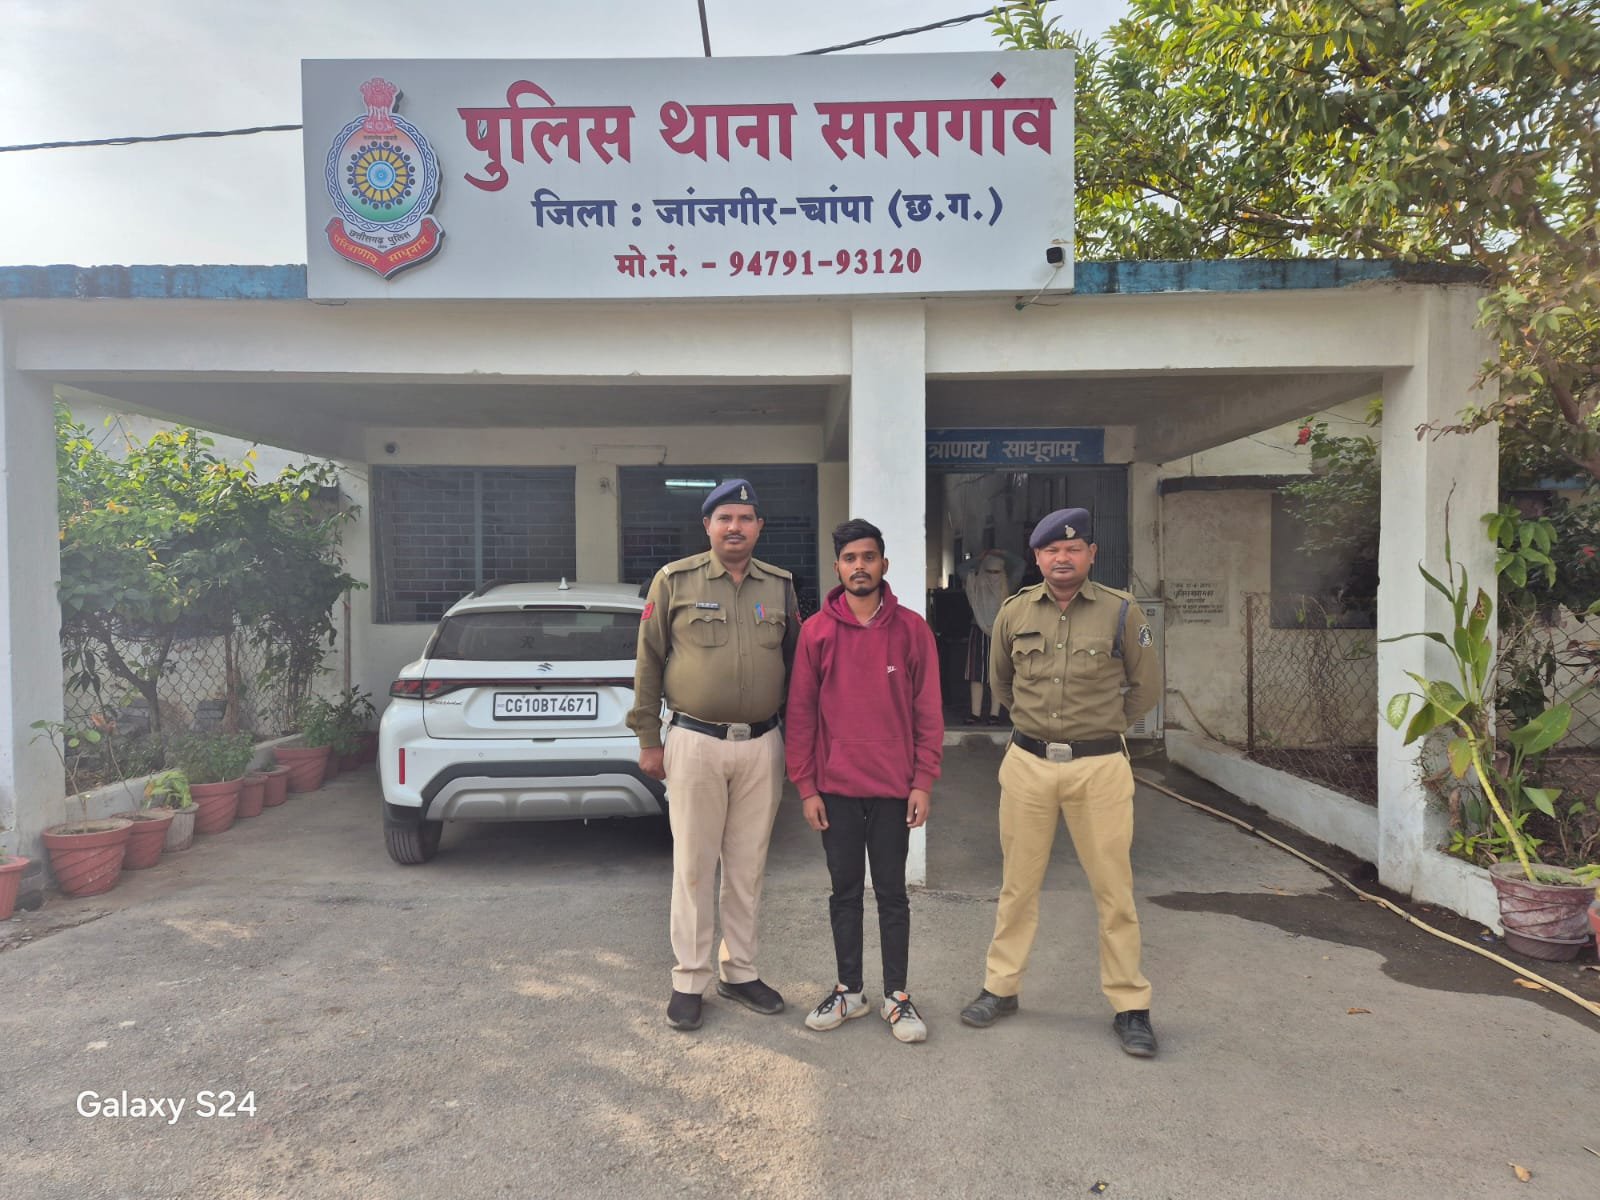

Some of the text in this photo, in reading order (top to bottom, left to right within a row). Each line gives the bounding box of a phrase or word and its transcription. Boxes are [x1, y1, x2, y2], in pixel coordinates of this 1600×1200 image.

[458, 74, 1056, 192] पुलिस थाना सारागांव
[530, 187, 618, 228] जिला
[652, 184, 874, 227] जांजगीर-चांपा
[888, 186, 1003, 229] (छ.ग.)
[730, 250, 922, 277] 94791-93120
[505, 697, 592, 713] CG10BT4671
